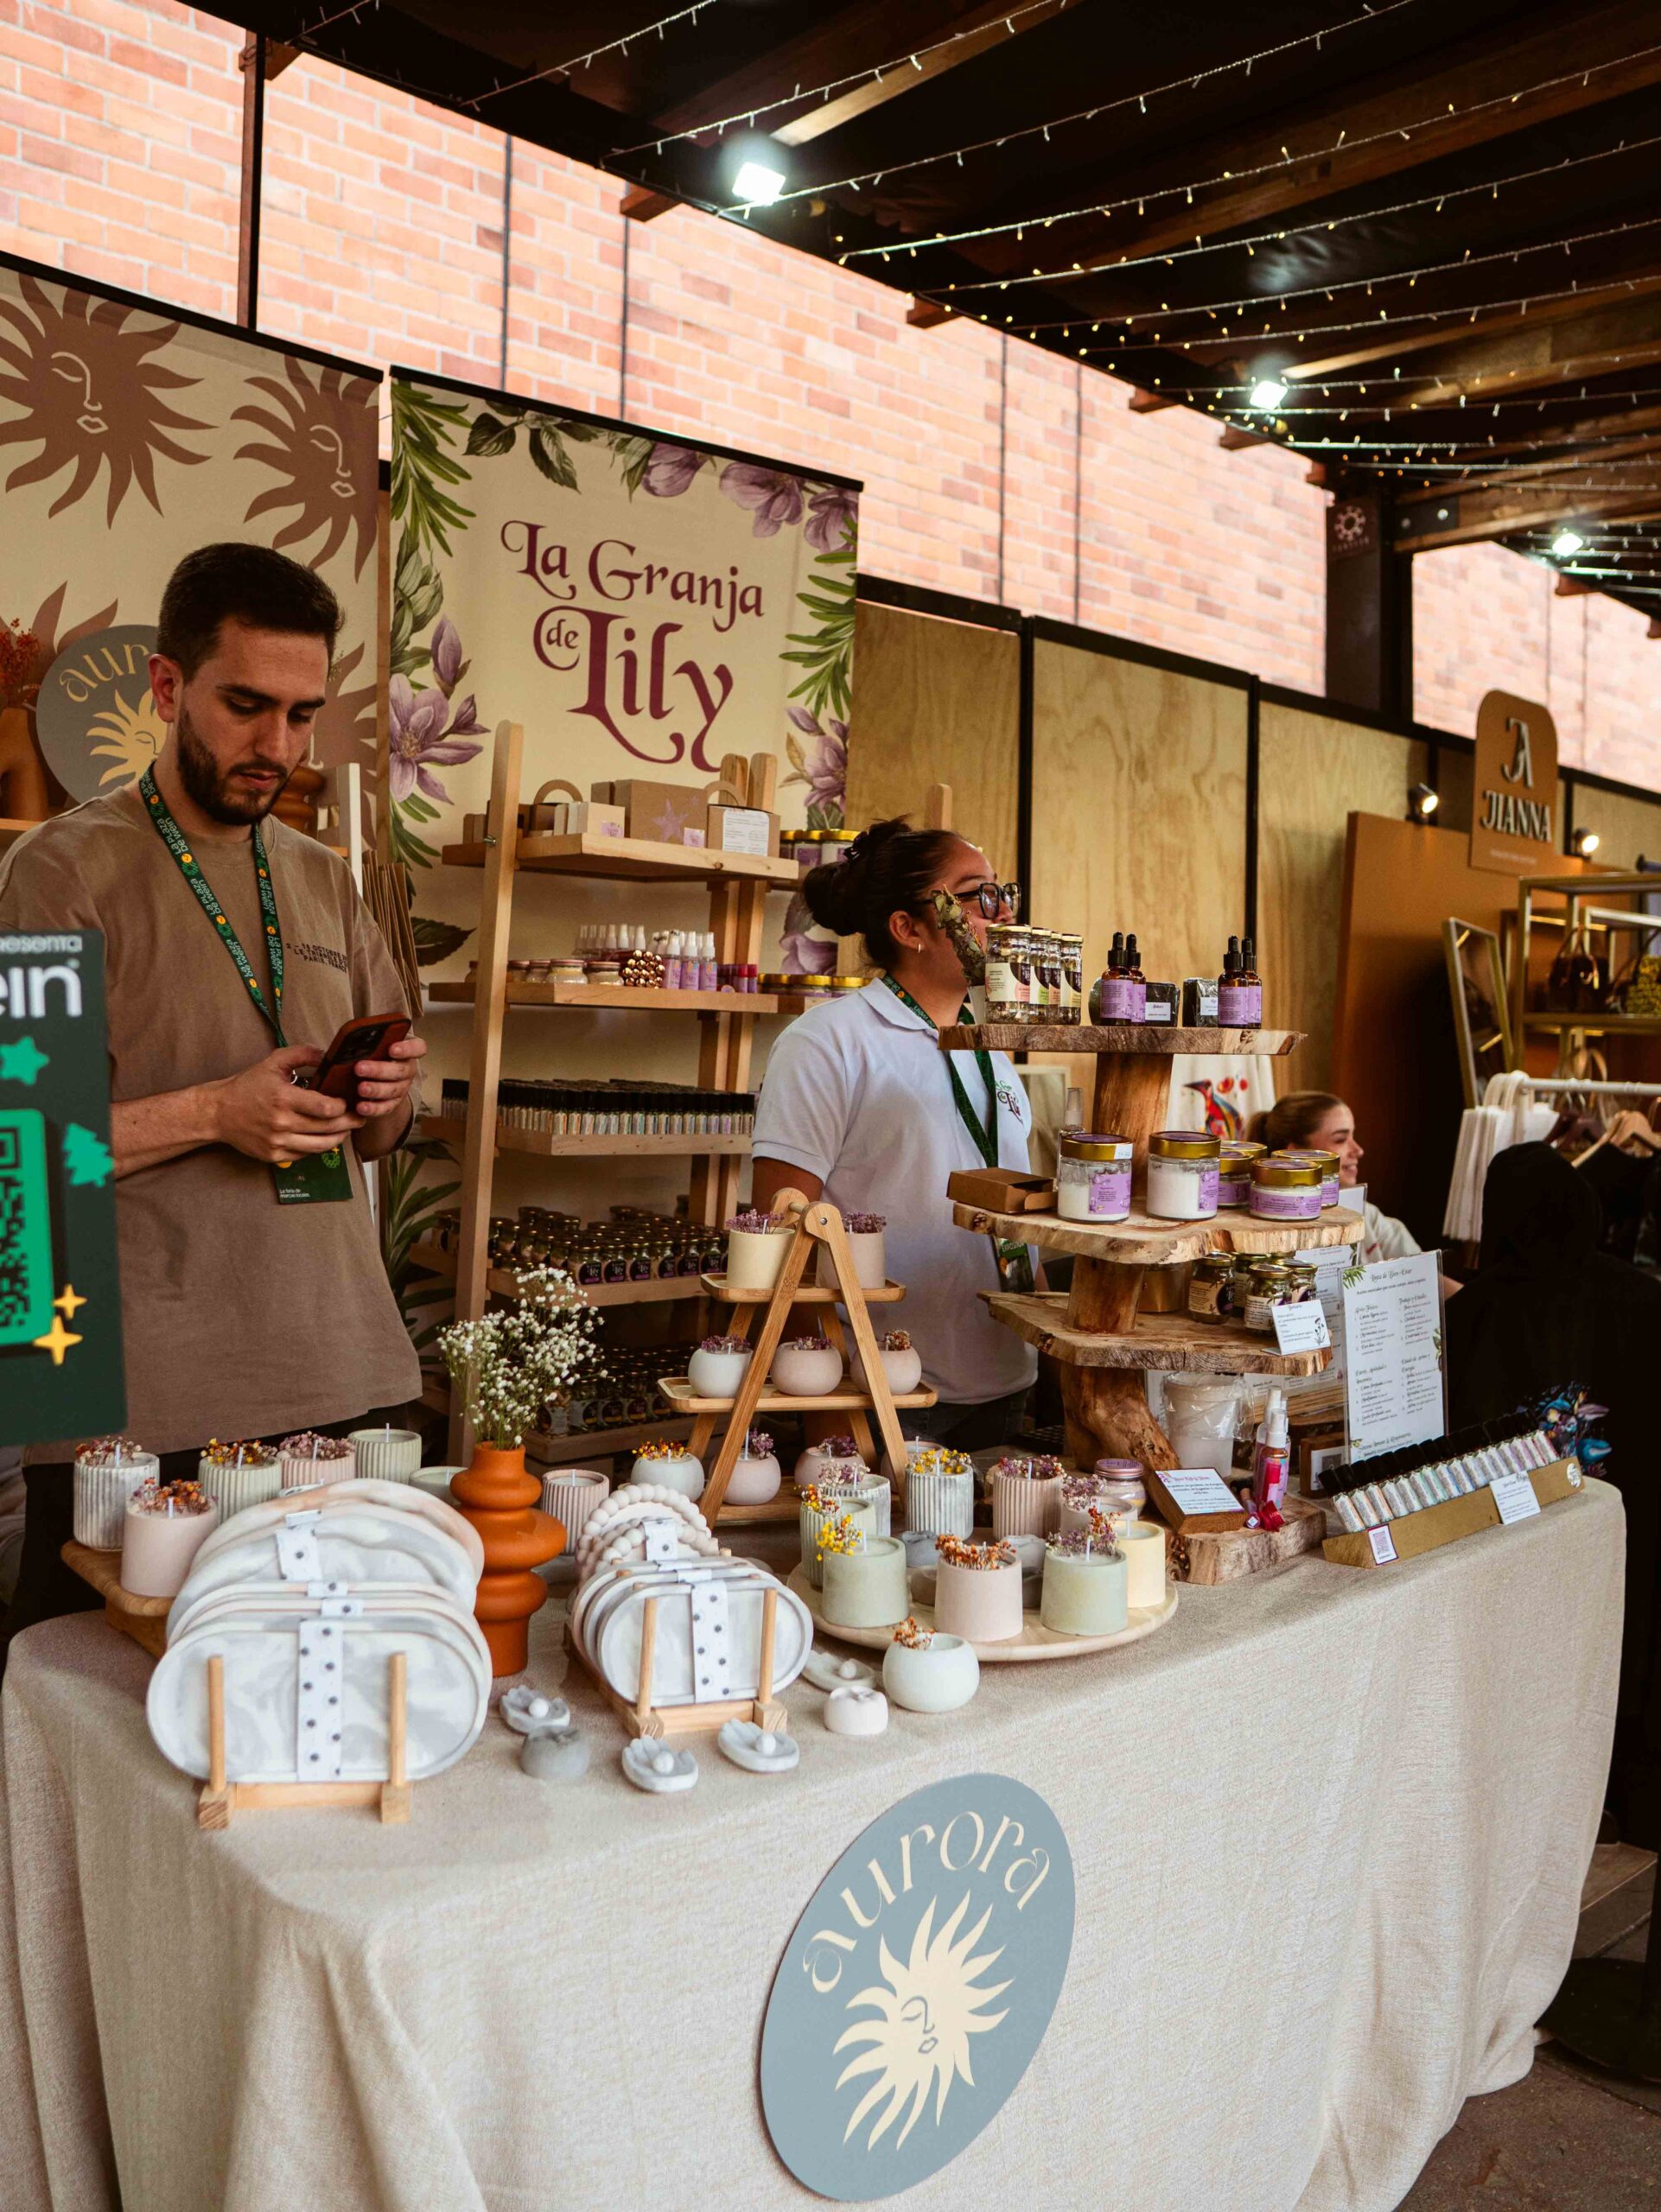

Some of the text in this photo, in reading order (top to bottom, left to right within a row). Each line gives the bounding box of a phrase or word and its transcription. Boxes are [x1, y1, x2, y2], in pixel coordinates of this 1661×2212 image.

[500, 520, 765, 632] La Granja
[59, 644, 150, 702] aur
[533, 606, 734, 772] de Lily
[1480, 790, 1552, 843] JIANNA
[802, 1811, 1050, 1993] aurora
